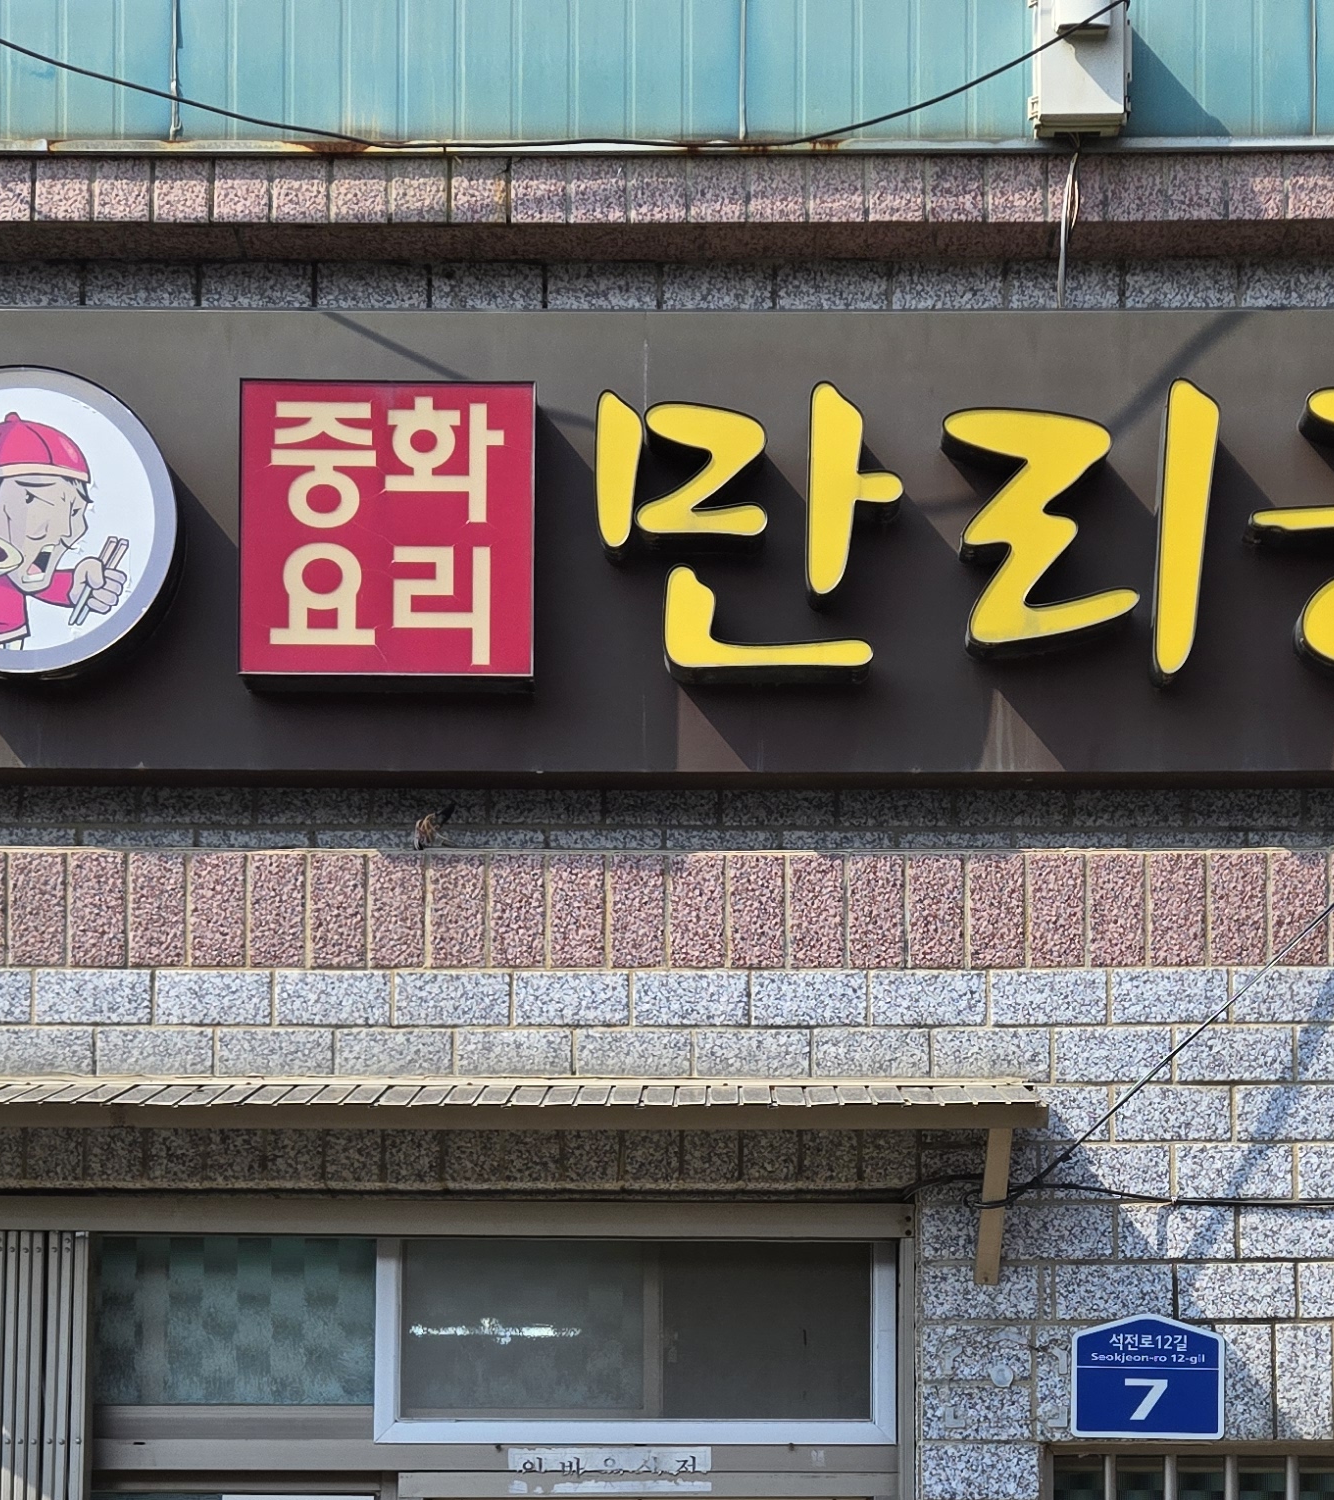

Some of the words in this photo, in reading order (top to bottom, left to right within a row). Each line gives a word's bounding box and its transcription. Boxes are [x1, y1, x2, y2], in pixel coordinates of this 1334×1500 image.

[269, 398, 507, 528] 중화
[269, 540, 495, 667] 요리
[1090, 1352, 1168, 1363] Seokjeon-ro
[1170, 1353, 1206, 1365] 12-gil
[1109, 1333, 1188, 1352] 석전로12길
[1124, 1377, 1169, 1421] 7
